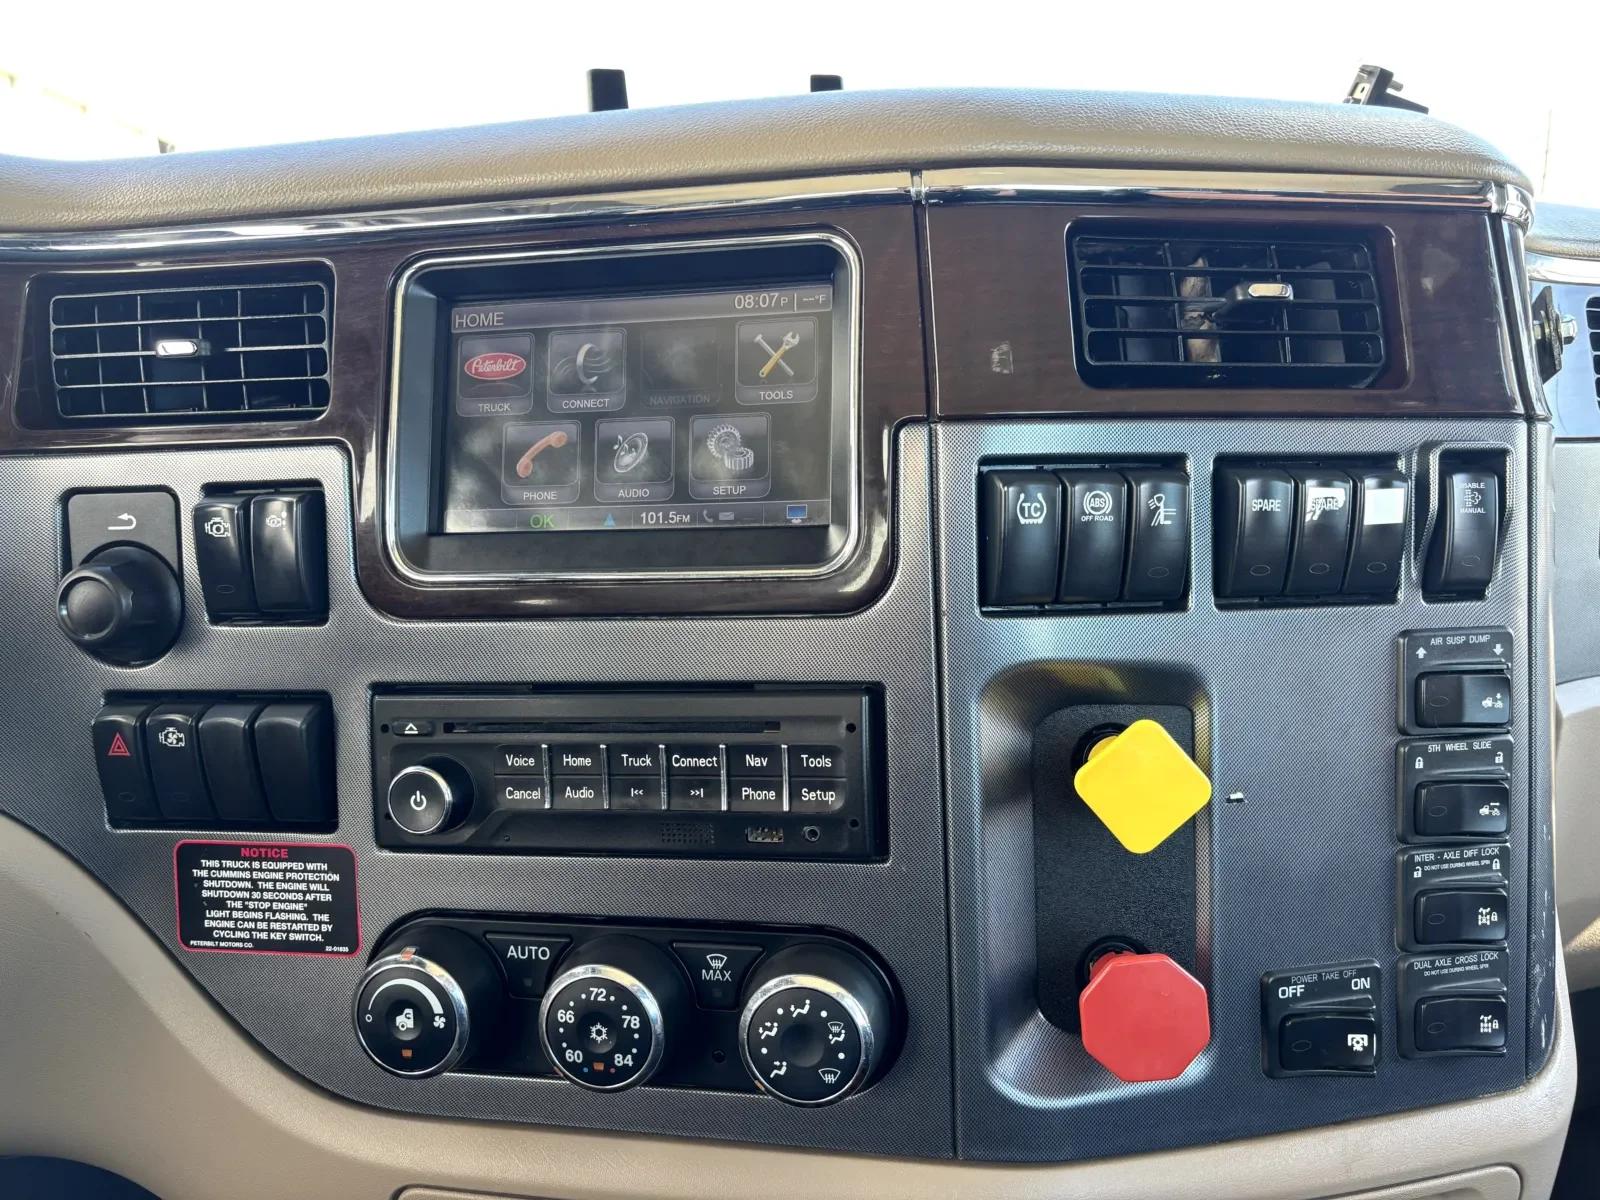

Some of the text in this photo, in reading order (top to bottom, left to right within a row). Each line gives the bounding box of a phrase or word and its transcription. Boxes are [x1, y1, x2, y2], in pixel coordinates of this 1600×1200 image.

[455, 312, 504, 328] HOME
[472, 357, 522, 375] Peterbilt
[649, 394, 711, 405] NAVIGATION
[760, 391, 793, 400] TOOLS
[479, 403, 511, 412] TRUCK
[562, 399, 610, 409] CONNECT
[523, 491, 557, 500] PHONE
[618, 489, 649, 498] AUDIO
[713, 486, 746, 495] SETUP
[1022, 502, 1041, 517] TC
[1089, 498, 1106, 508] ABS
[1252, 499, 1281, 512] SPARE
[530, 513, 554, 528] OK
[1430, 635, 1491, 646] AIR SUSP DUMP
[1428, 740, 1492, 753] 5TH WHEEL SLIDE
[506, 754, 535, 766] Voice
[563, 754, 592, 766] Home
[621, 754, 652, 767] Truck
[672, 754, 718, 768] Connect
[746, 754, 768, 768] Nav
[801, 754, 832, 768] Tools
[506, 786, 541, 800] Cancel
[565, 786, 594, 799] Audio
[742, 787, 776, 800] Phone
[802, 788, 836, 805] Setup
[241, 848, 289, 859] NOTICE
[1414, 852, 1435, 862] INTER
[1443, 850, 1461, 860] AXLE
[1463, 848, 1479, 858] DIFF
[1481, 846, 1500, 856] LOCK
[200, 860, 220, 868] THIS
[222, 860, 251, 869] TRUCK
[262, 862, 305, 870] EQUIPPED
[306, 862, 328, 871] WITH
[192, 869, 340, 882] THE CUMMINS ENGINE PROTECTION
[202, 880, 330, 892] SHUTDOWN. THE ENGINE WILL
[202, 890, 332, 902] SHUTDOWN 30 SECONDS AFTER
[226, 900, 308, 911] THE "STOP ENGINE"
[206, 910, 330, 922] LIGHT BEGINS FLASHING. THE
[204, 920, 334, 932] ENGINE CAN BE RESTARTED BY
[212, 930, 325, 942] CYCLING THE KEY SWITCH.
[507, 945, 550, 960] AUTO
[1414, 952, 1500, 970] DUAL AXLE CROSS LOCK
[701, 969, 732, 982] MAX
[1291, 969, 1357, 984] POWER TAKE OFF
[1351, 976, 1371, 991] ON
[589, 988, 606, 1002] 72
[1278, 984, 1305, 999] OFF
[557, 1009, 575, 1024] 66
[622, 1016, 640, 1029] 78
[565, 1050, 583, 1063] 60
[614, 1054, 634, 1068] 84
